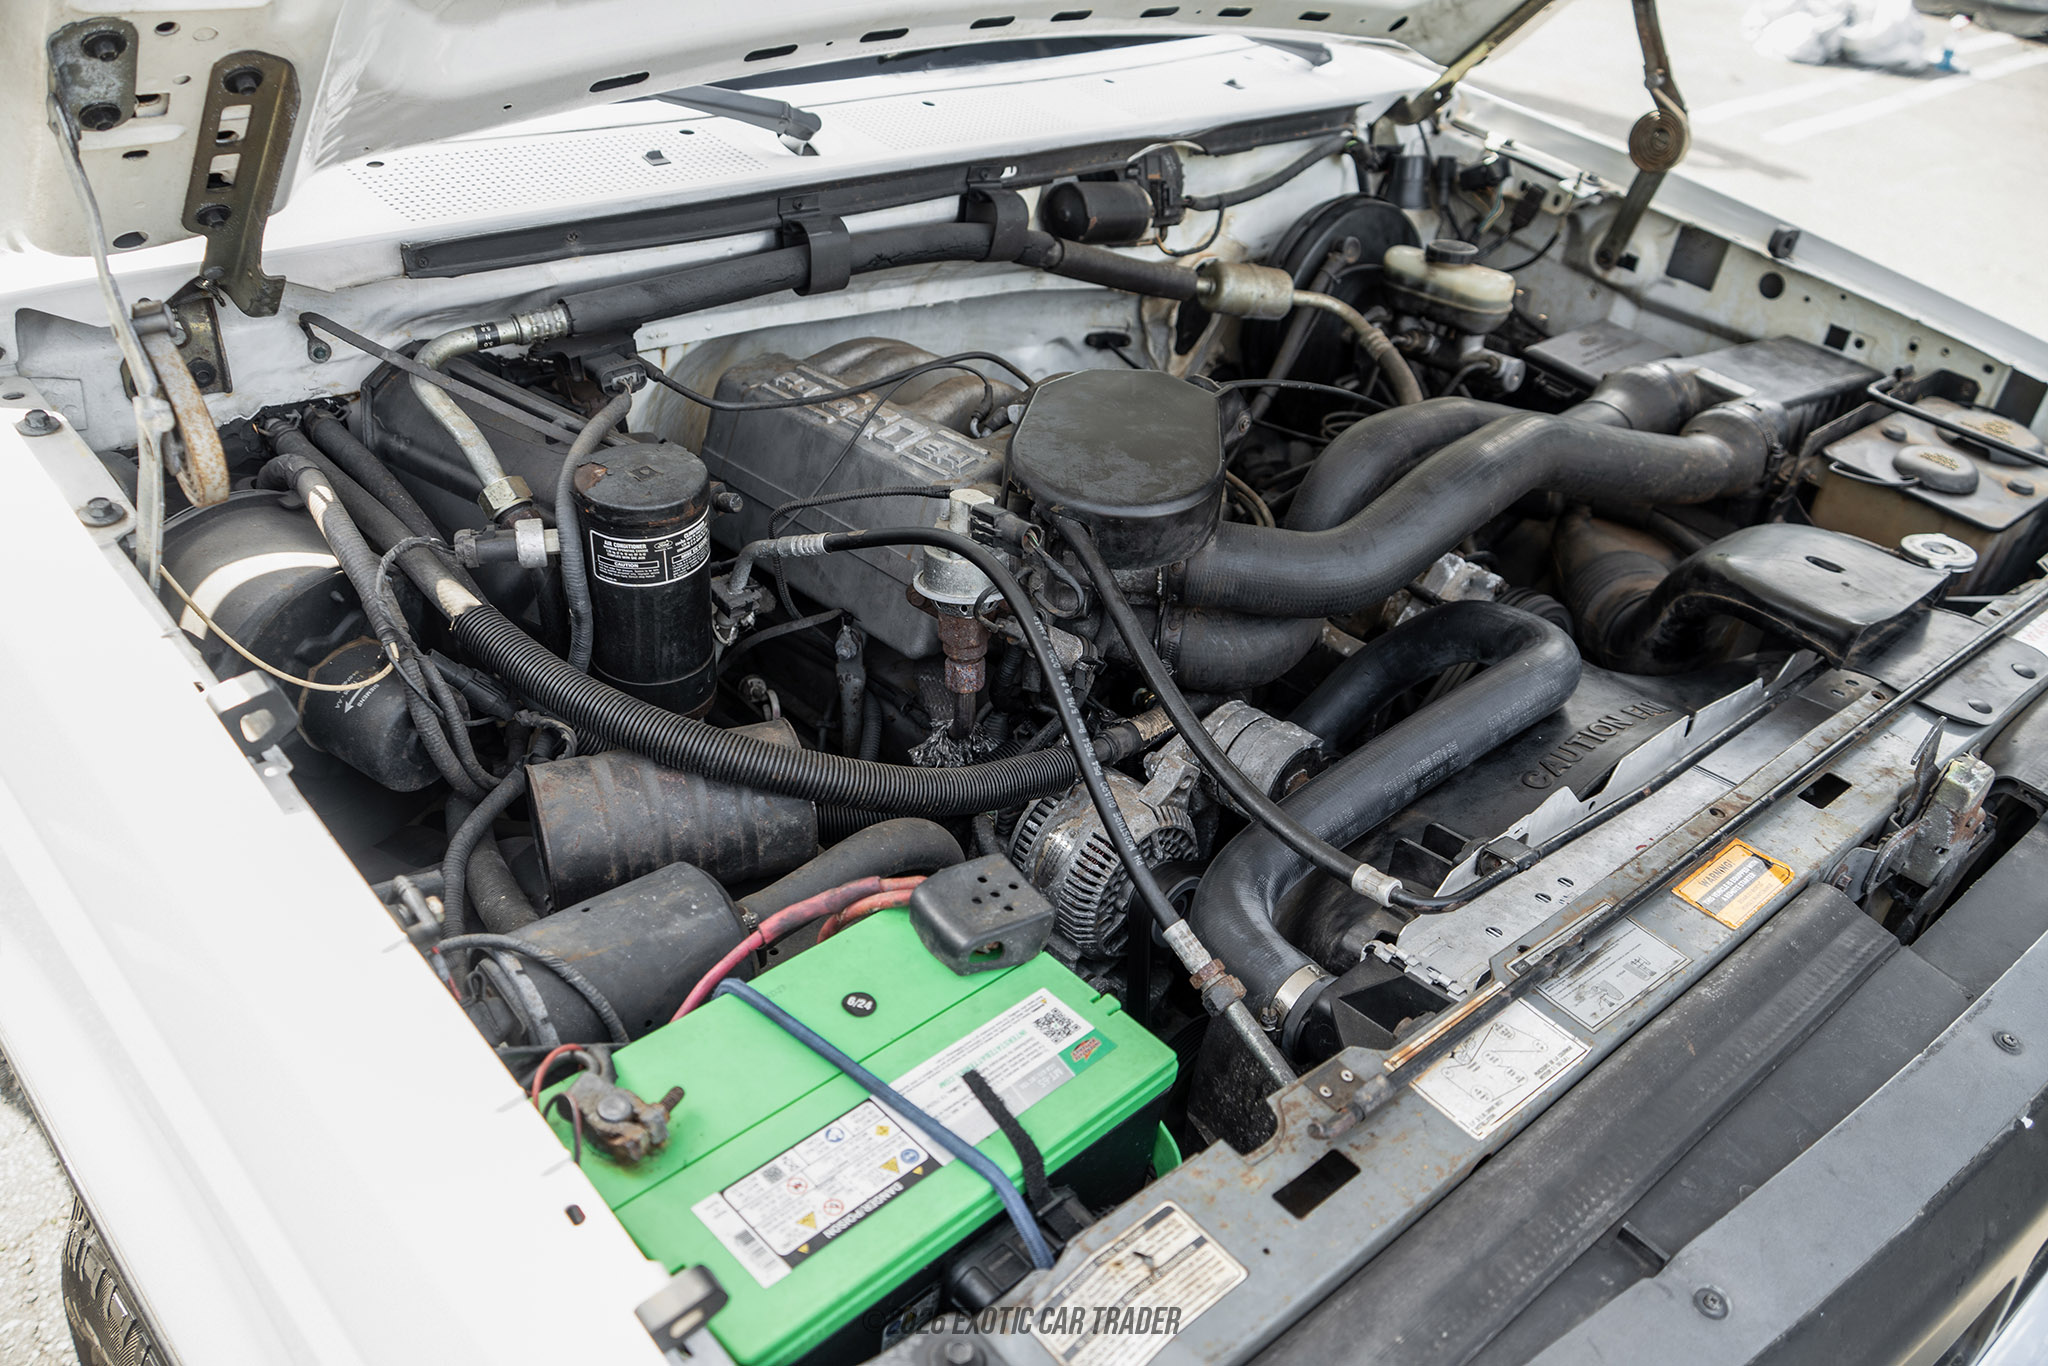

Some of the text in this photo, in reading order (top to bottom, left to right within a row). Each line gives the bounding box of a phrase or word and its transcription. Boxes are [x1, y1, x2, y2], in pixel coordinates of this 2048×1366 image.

[357, 683, 380, 707] SIEMENS
[1522, 714, 1633, 789] CAUTION
[1100, 781, 1117, 809] GUARD
[1113, 811, 1137, 852] MOISTURE
[1698, 858, 1736, 888] WARNING!
[846, 995, 873, 1010] 6/24
[822, 1180, 905, 1240] DANGER/POISON
